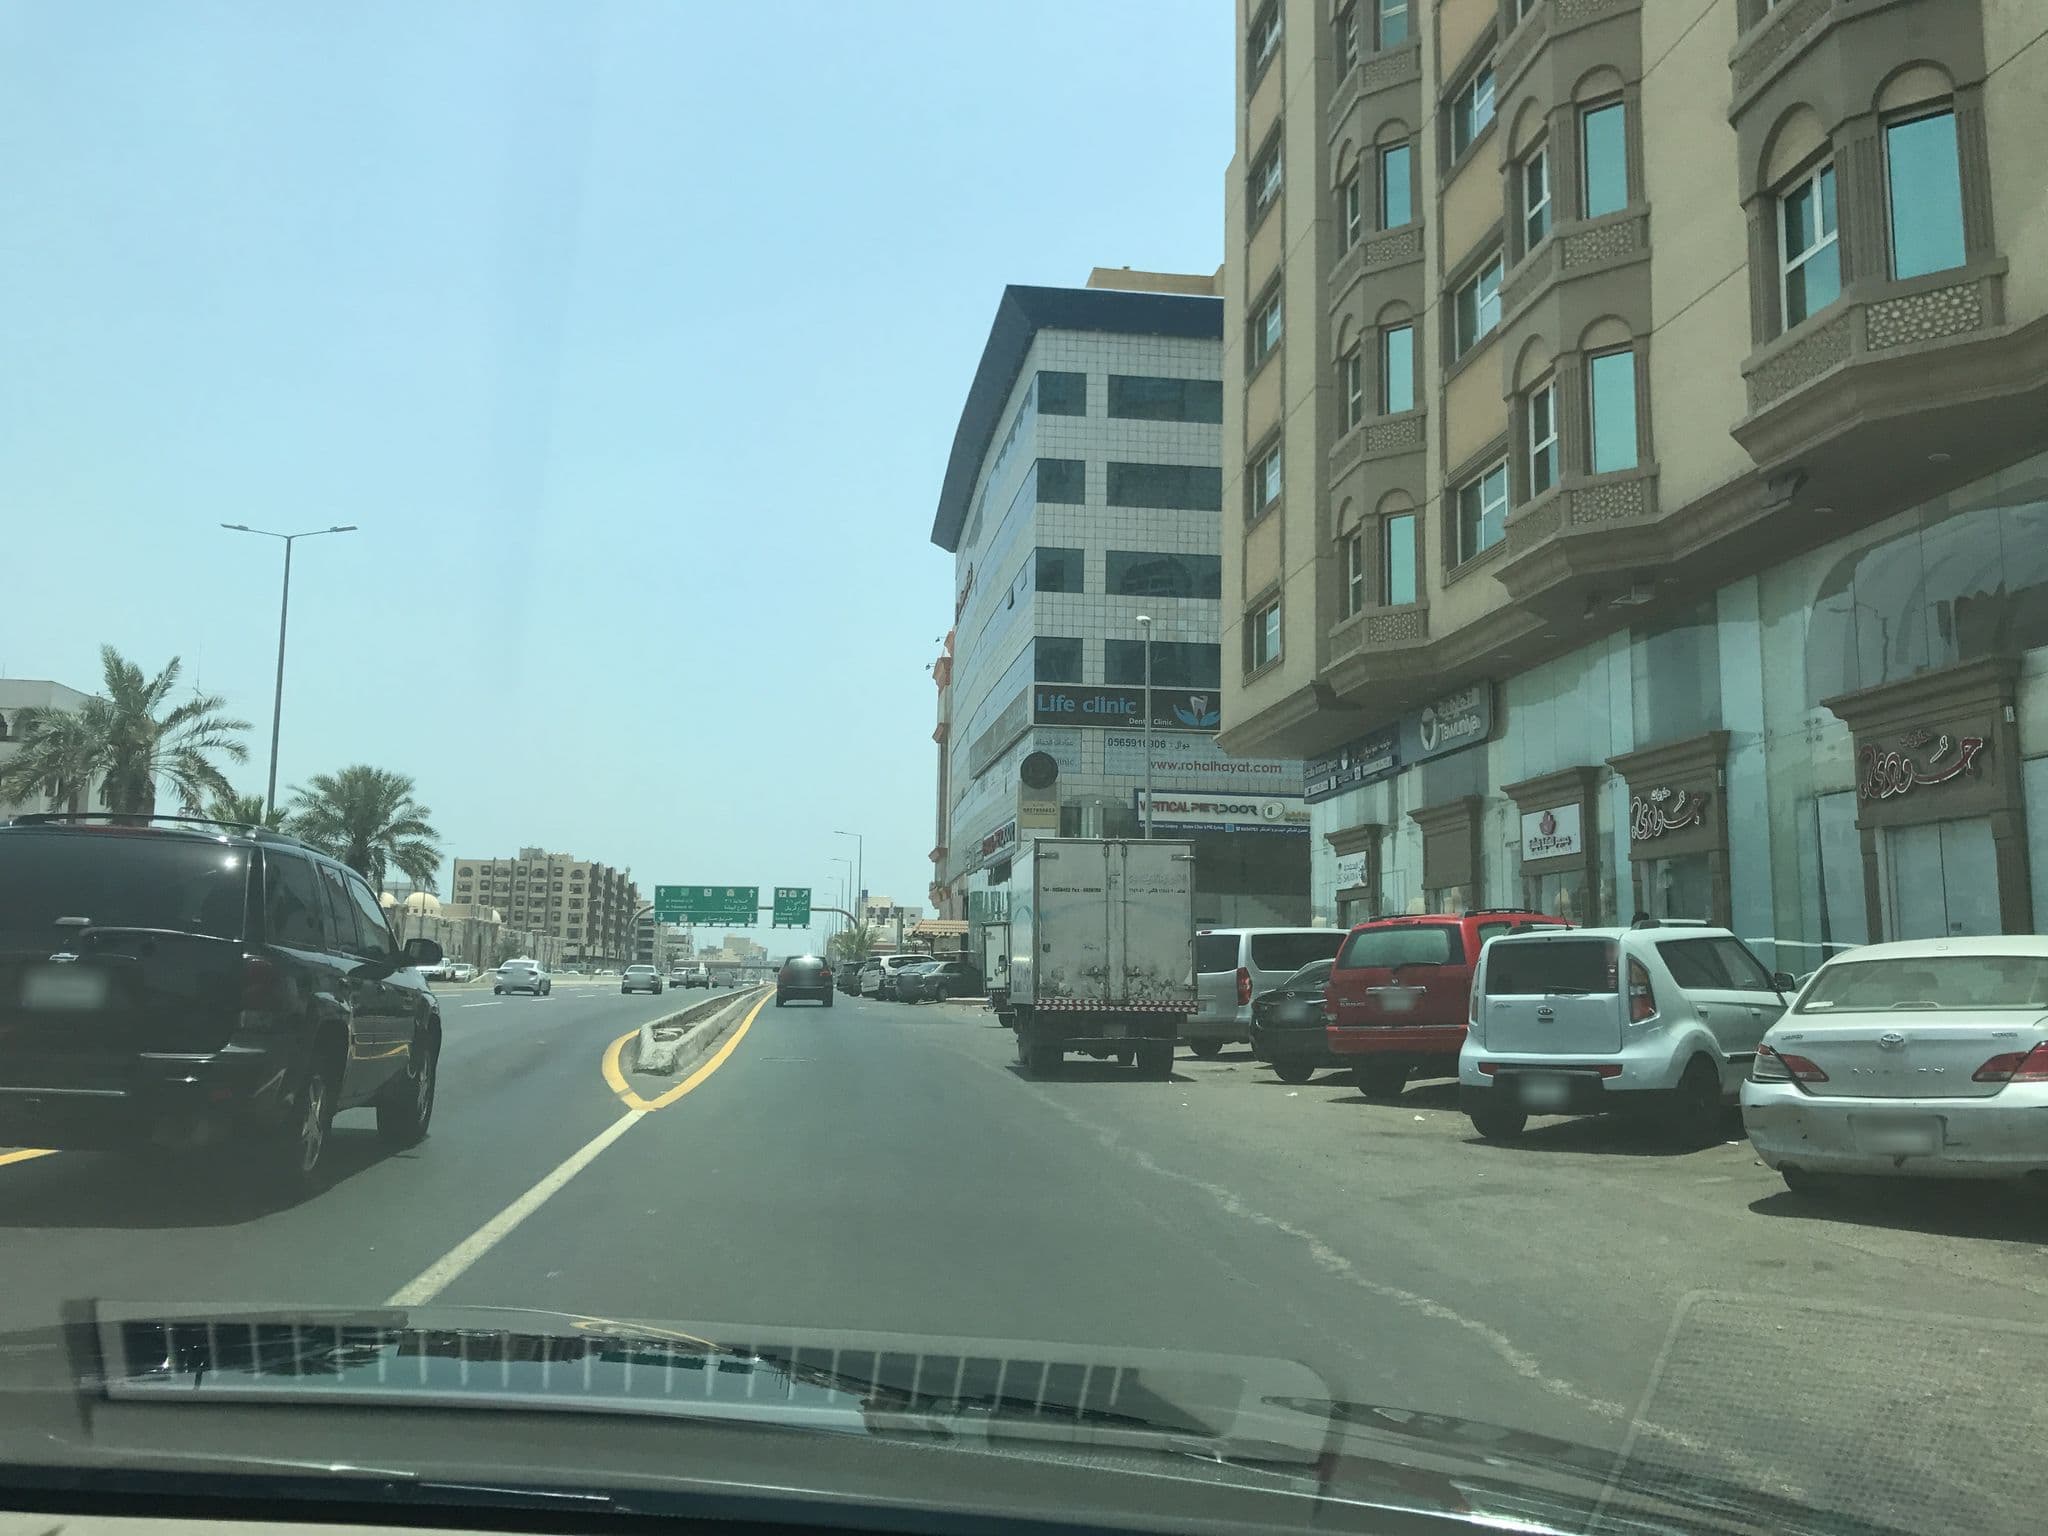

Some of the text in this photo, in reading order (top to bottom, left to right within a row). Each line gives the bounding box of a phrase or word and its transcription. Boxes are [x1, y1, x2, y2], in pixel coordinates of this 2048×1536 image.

[1036, 693, 1137, 715] Life clinic
[1128, 717, 1175, 726] Dent Clinic
[1438, 713, 1481, 741] Tawuniya
[1139, 800, 1190, 813] VRTICAL
